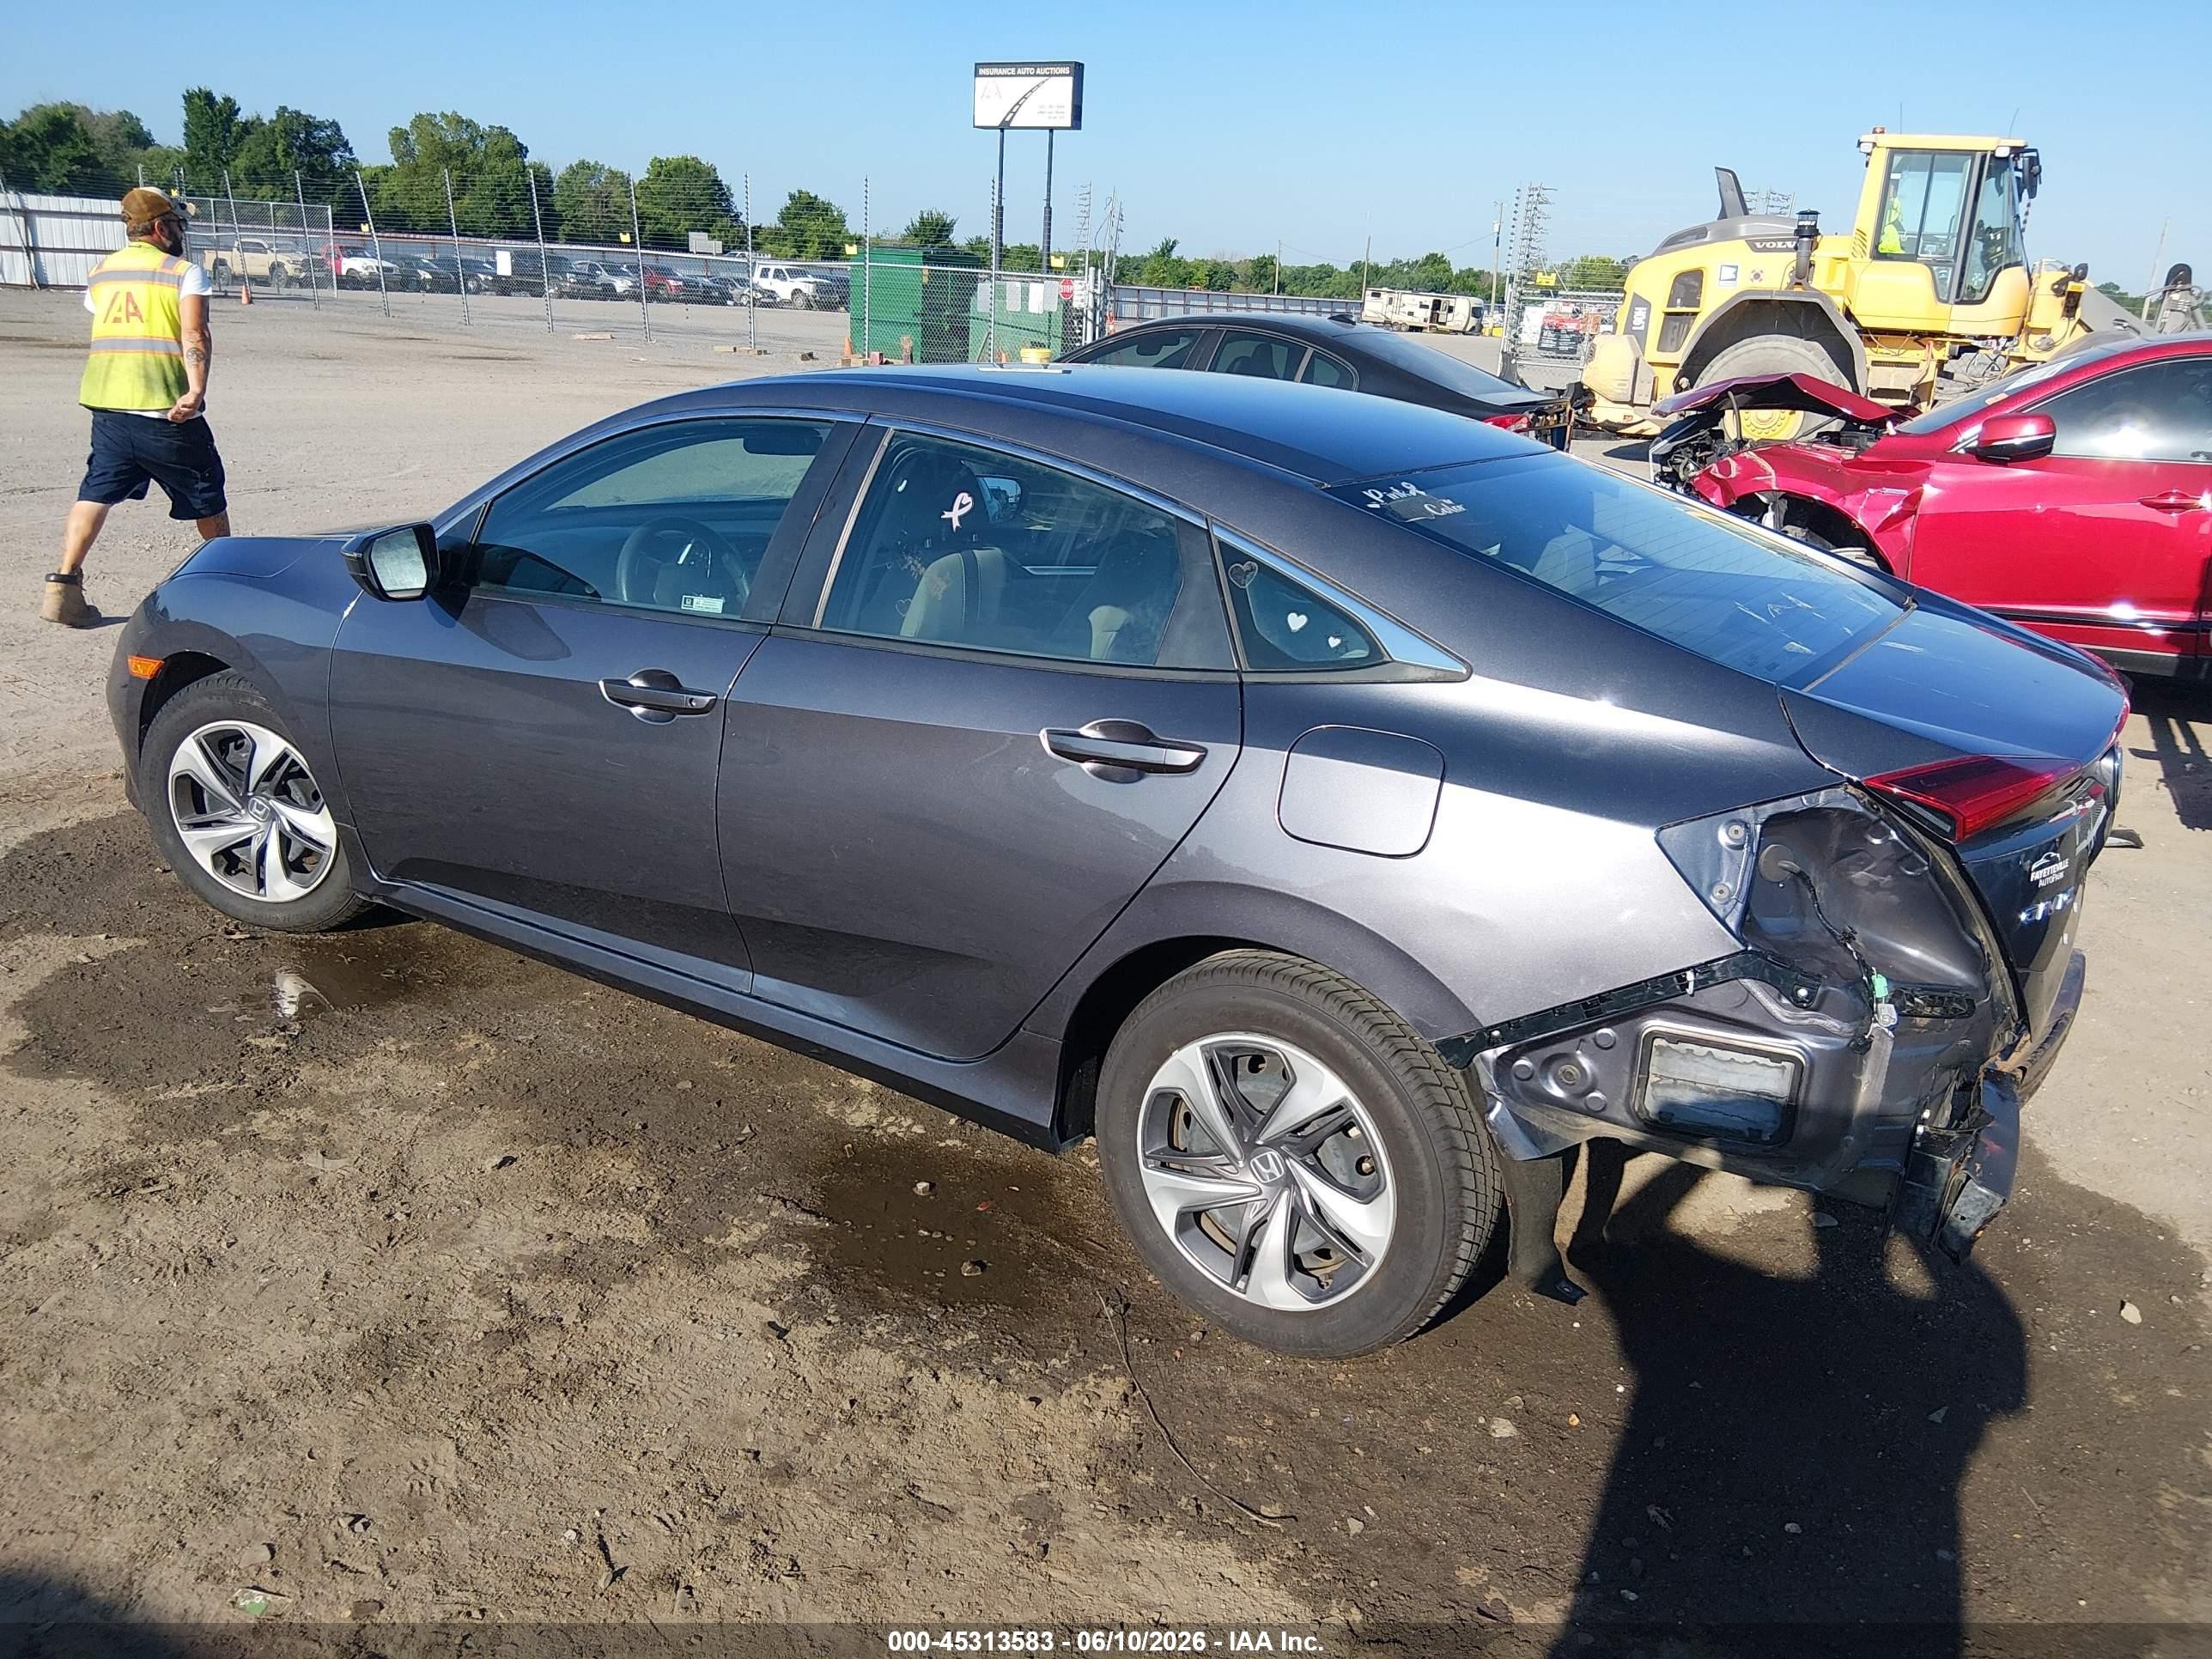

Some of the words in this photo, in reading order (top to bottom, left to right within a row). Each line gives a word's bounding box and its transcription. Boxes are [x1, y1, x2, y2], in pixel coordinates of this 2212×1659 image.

[979, 67, 1016, 76] INSURANCE
[1036, 66, 1071, 76] AUCTIONS
[1753, 240, 1796, 249] VOLV
[1060, 284, 1073, 294] STOP
[2029, 858, 2070, 882] FAYETTEVILLE
